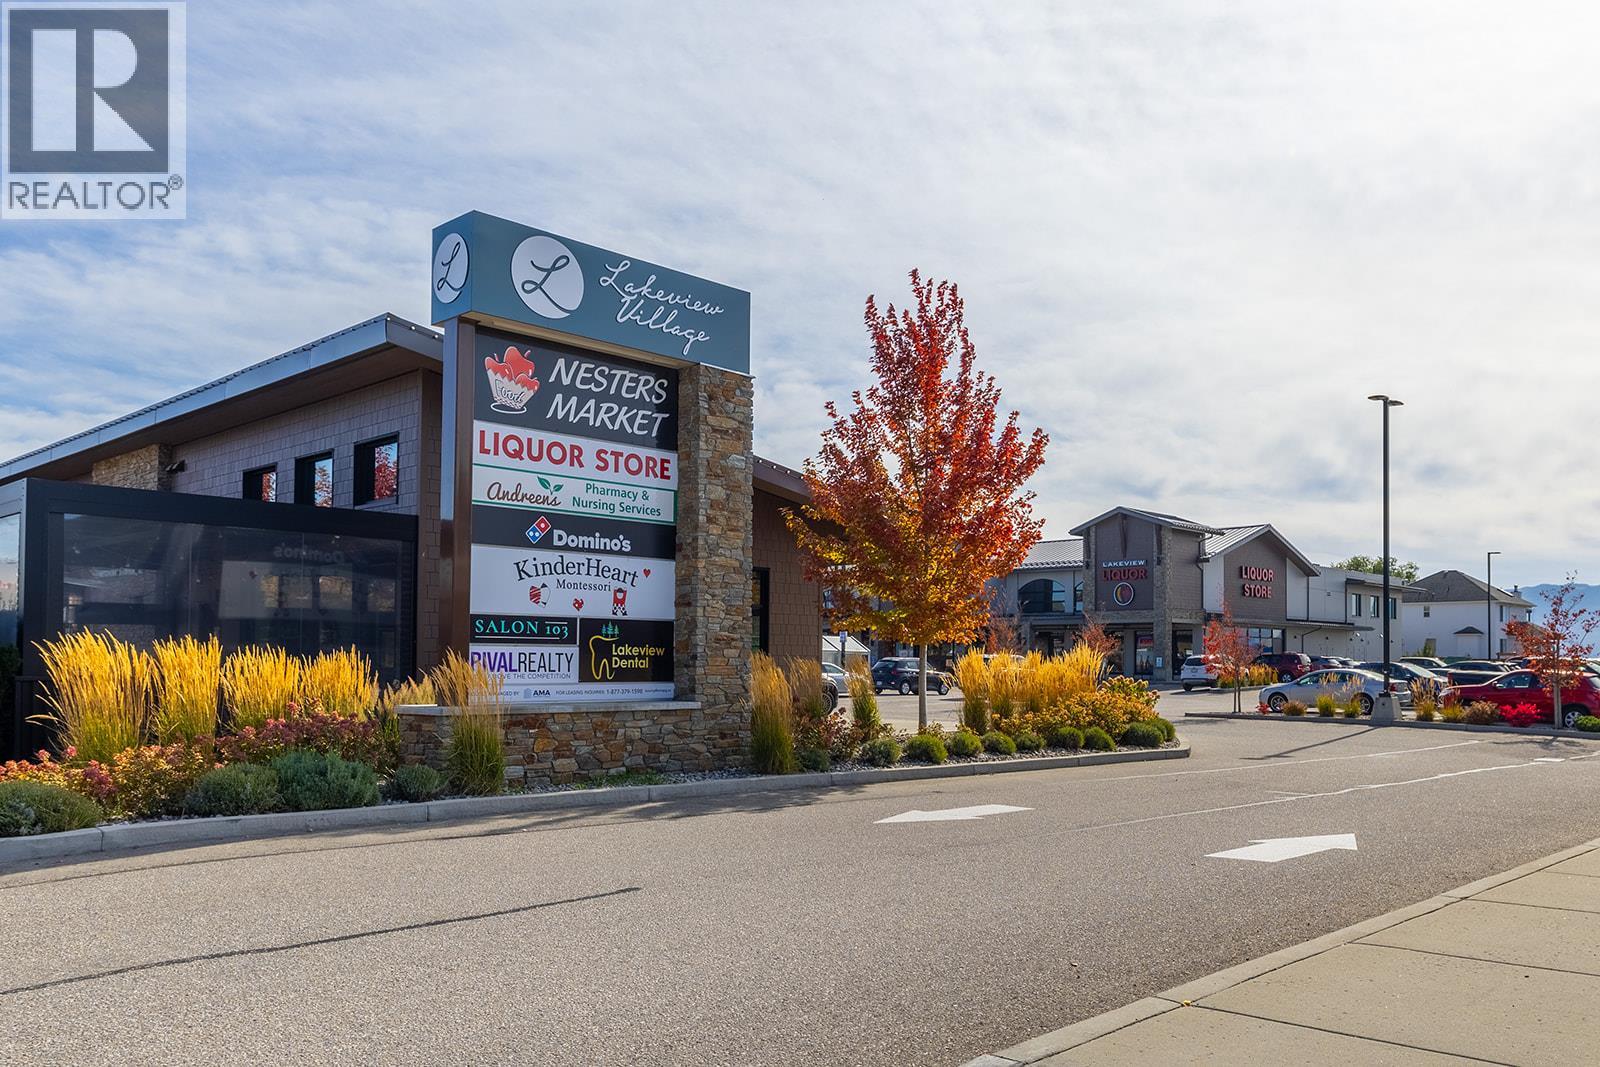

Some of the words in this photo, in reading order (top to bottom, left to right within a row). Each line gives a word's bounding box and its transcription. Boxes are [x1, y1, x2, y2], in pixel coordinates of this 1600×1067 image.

[521, 254, 577, 316] L
[599, 259, 725, 315] Lakeview
[617, 296, 710, 356] Village
[549, 358, 668, 405] NESTERS
[546, 393, 669, 437] MARKET
[479, 430, 585, 468] LIQUOR
[595, 448, 671, 480] STORE
[585, 482, 639, 501] Pharmacy
[641, 490, 650, 501] &
[572, 496, 615, 514] Nursing
[619, 501, 661, 517] Services
[553, 529, 632, 553] Domino's
[514, 555, 639, 588] KinderHeart
[1102, 559, 1147, 568] LAKEVIEW
[1241, 565, 1274, 582] LIQUOR
[1102, 568, 1147, 581] LIQUOR
[556, 579, 611, 592] Montessori
[1243, 583, 1272, 599] STORE
[475, 619, 539, 634] SALON
[546, 625, 569, 639] 103
[612, 644, 665, 656] Lakeview
[612, 657, 649, 668] Dental
[533, 689, 551, 697] AMA
